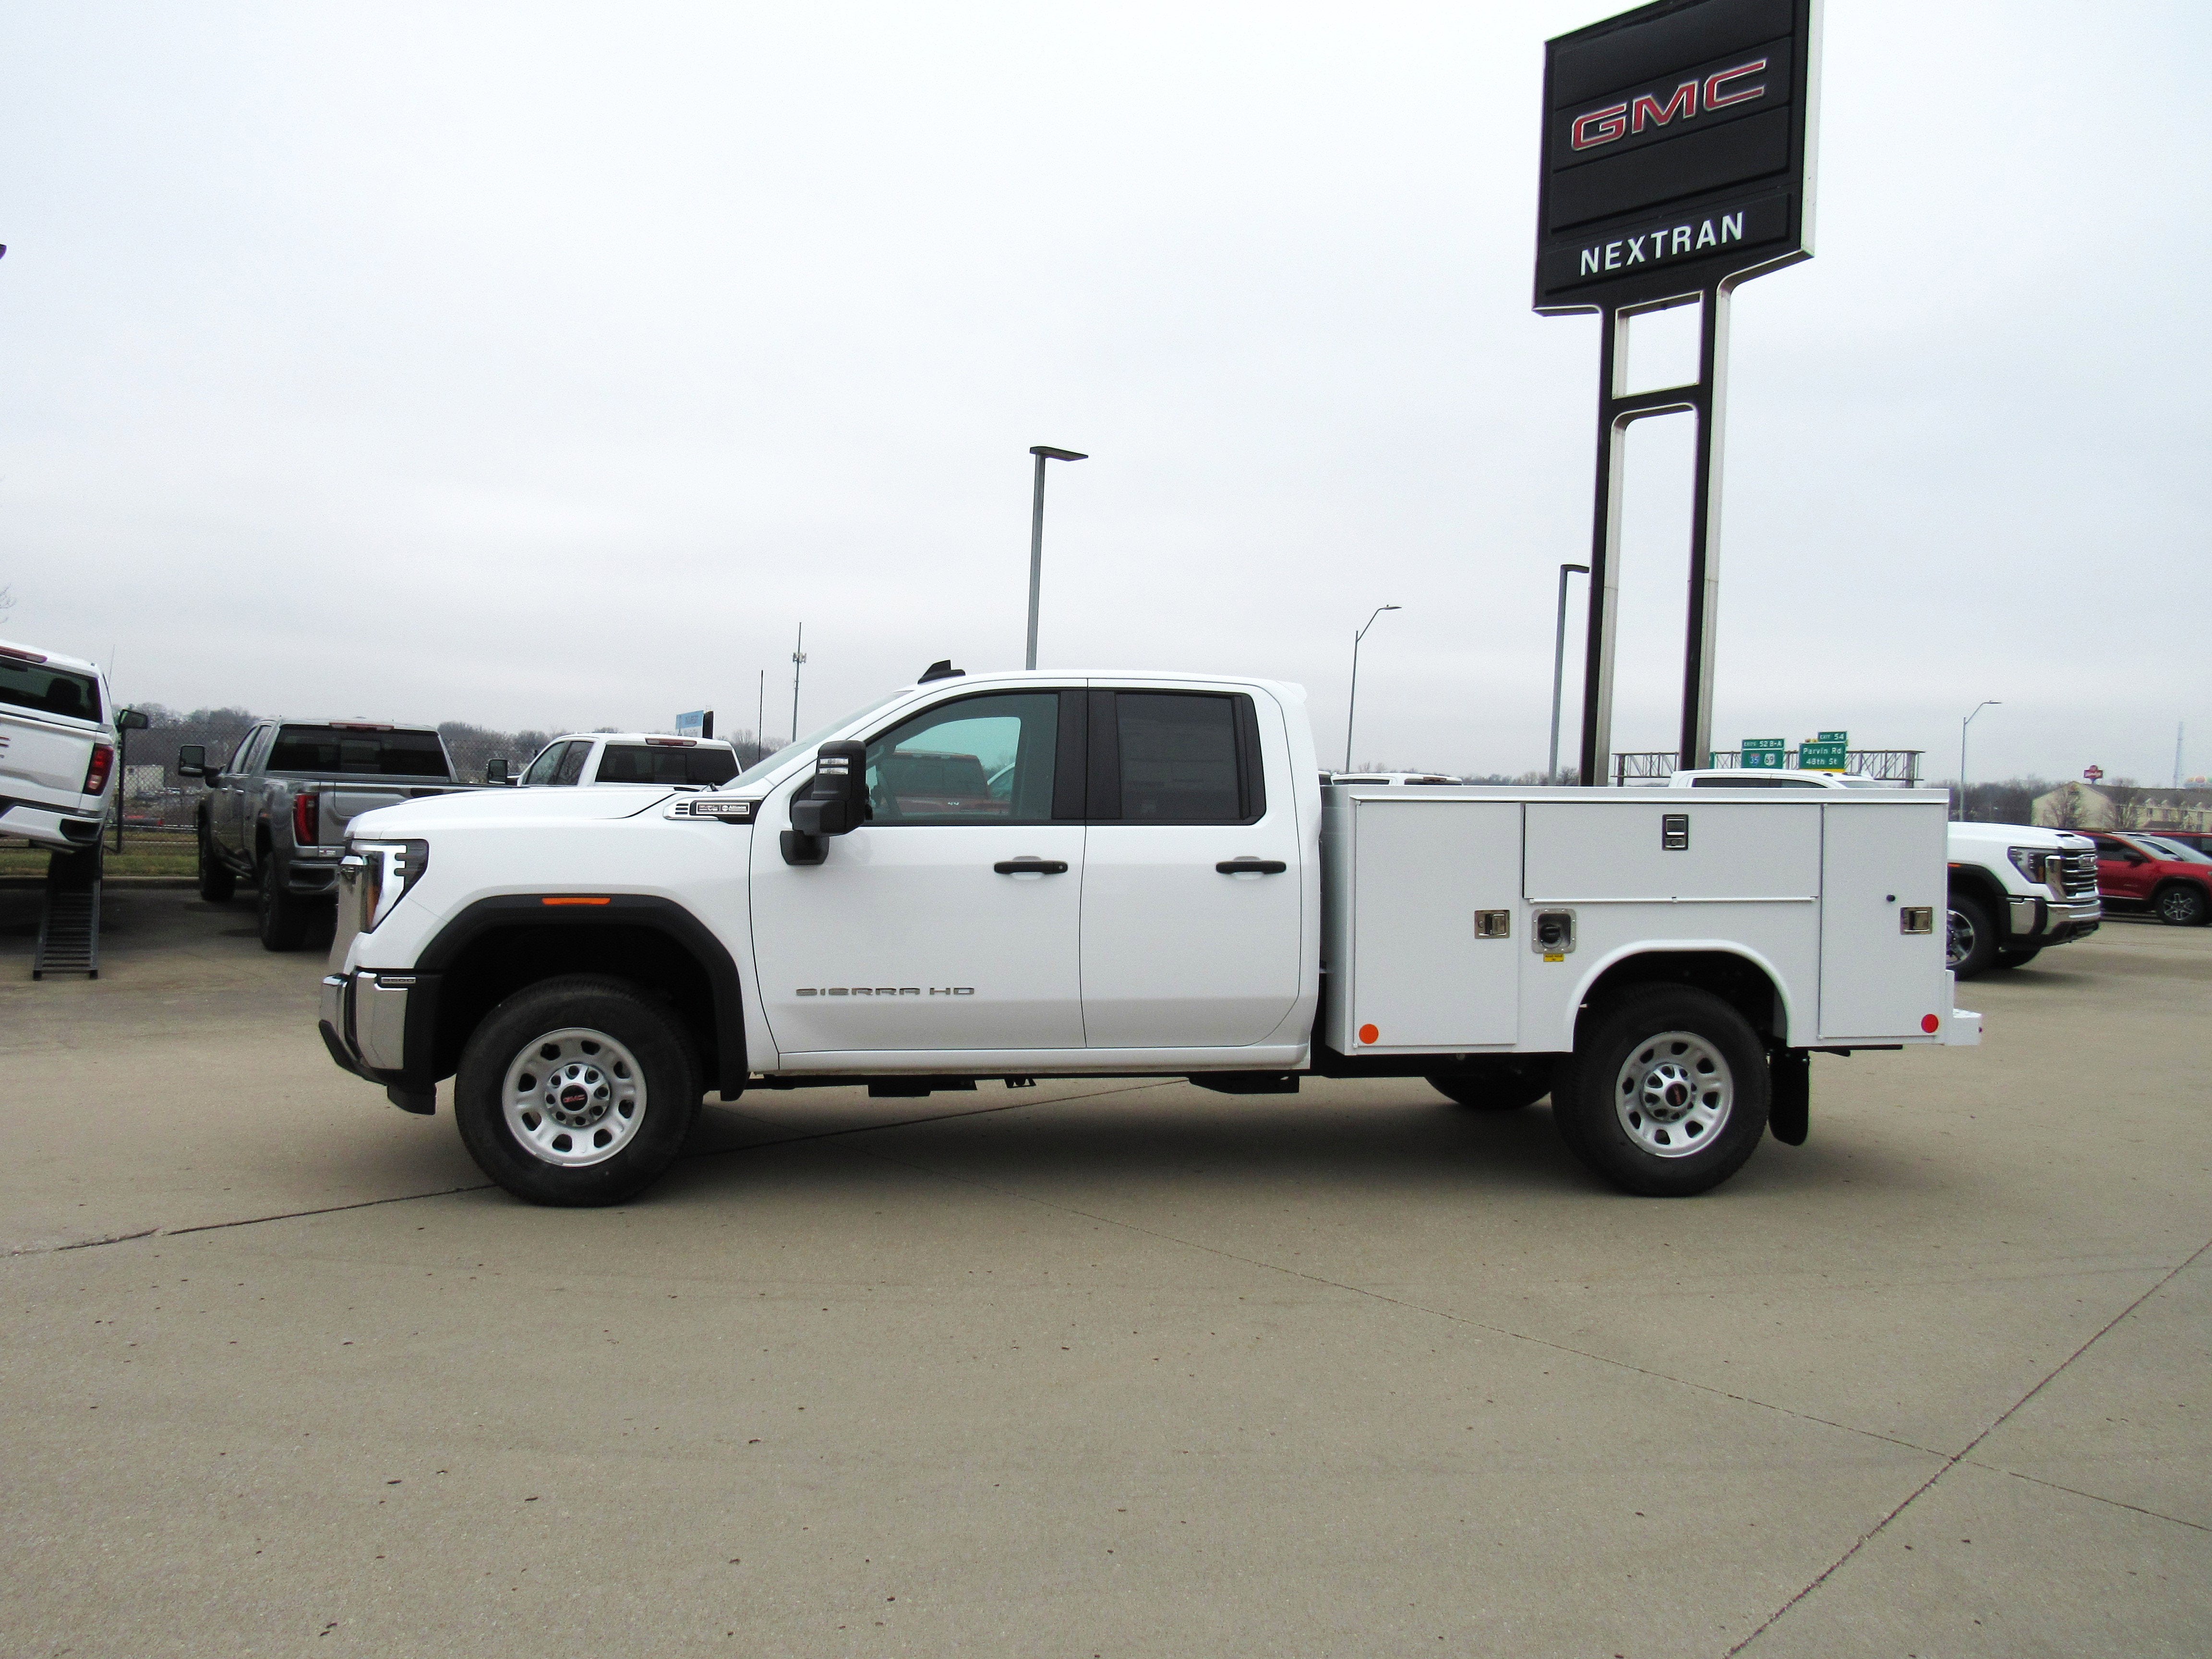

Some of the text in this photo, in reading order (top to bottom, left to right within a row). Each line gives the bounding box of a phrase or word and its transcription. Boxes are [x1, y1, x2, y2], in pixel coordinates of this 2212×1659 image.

[1571, 58, 1767, 151] GMC
[1580, 211, 1744, 276] NEXTRAN
[563, 1094, 585, 1103] GMC
